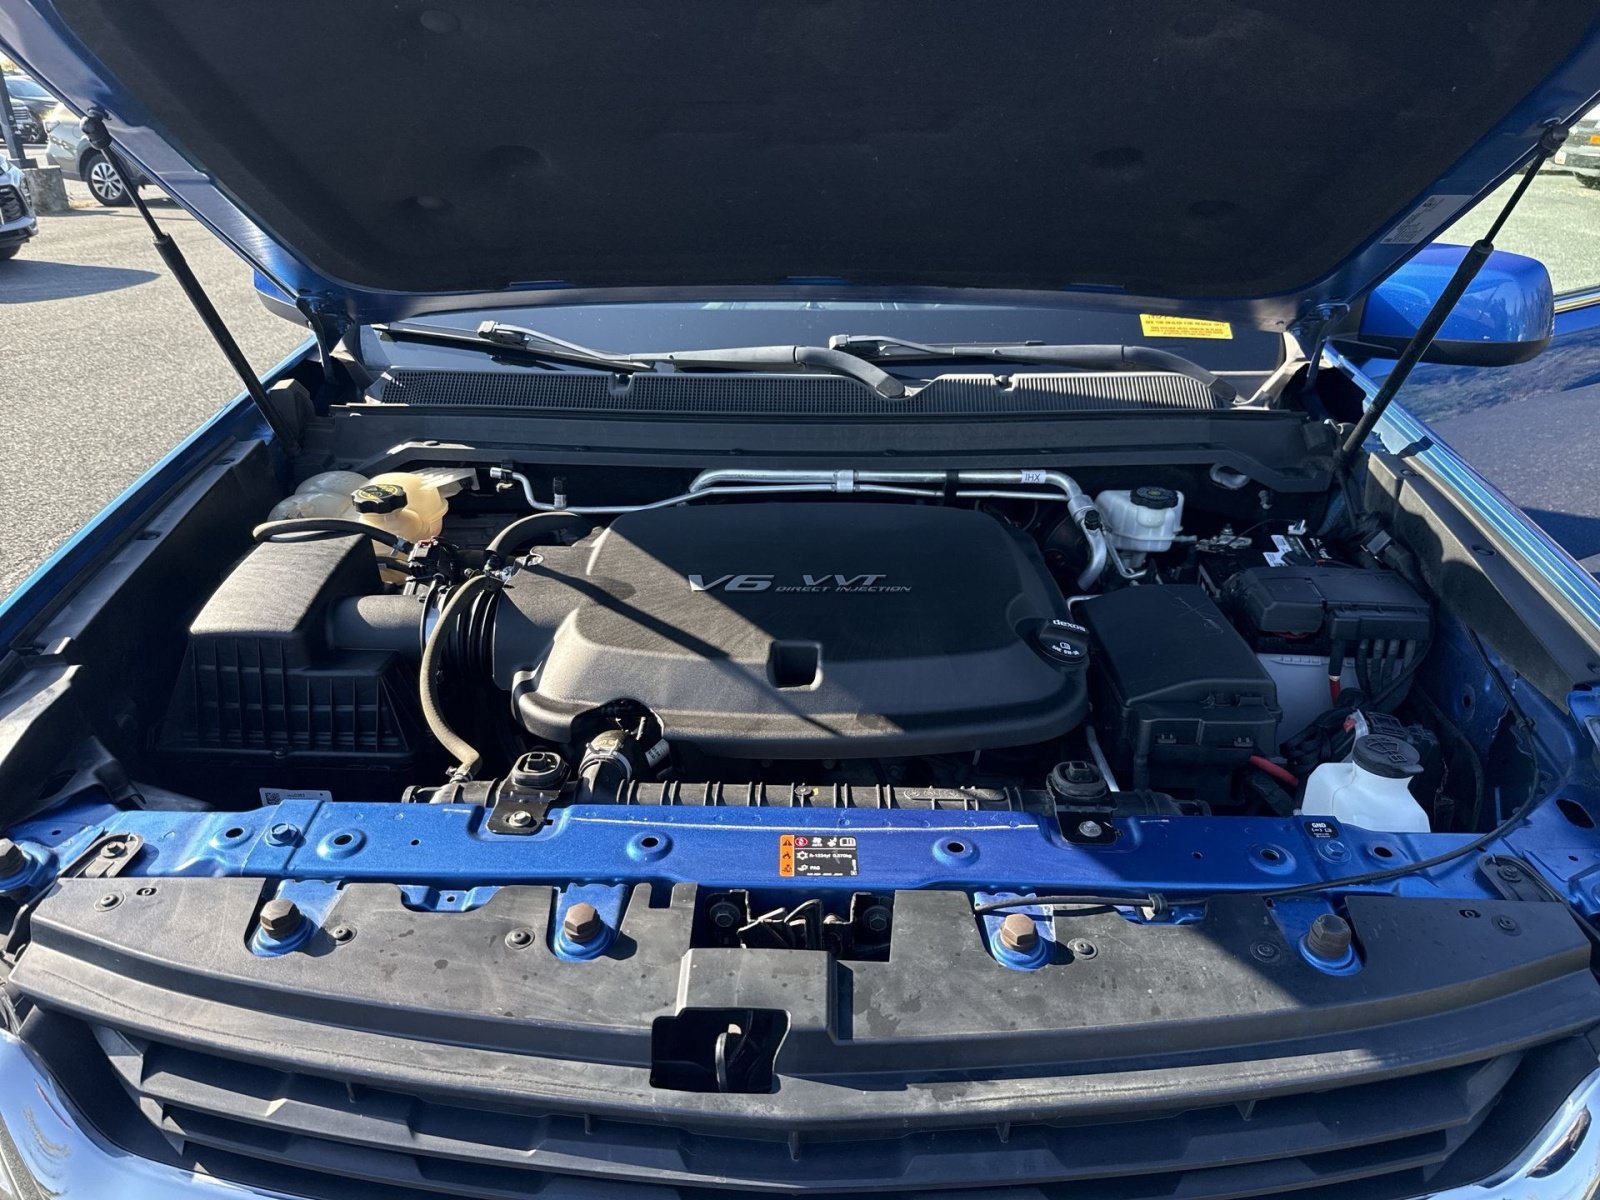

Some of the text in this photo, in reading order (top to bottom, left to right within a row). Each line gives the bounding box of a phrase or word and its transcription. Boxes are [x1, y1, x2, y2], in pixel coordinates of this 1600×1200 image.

[688, 574, 888, 591] V6 VVT
[1052, 619, 1086, 632] dexos
